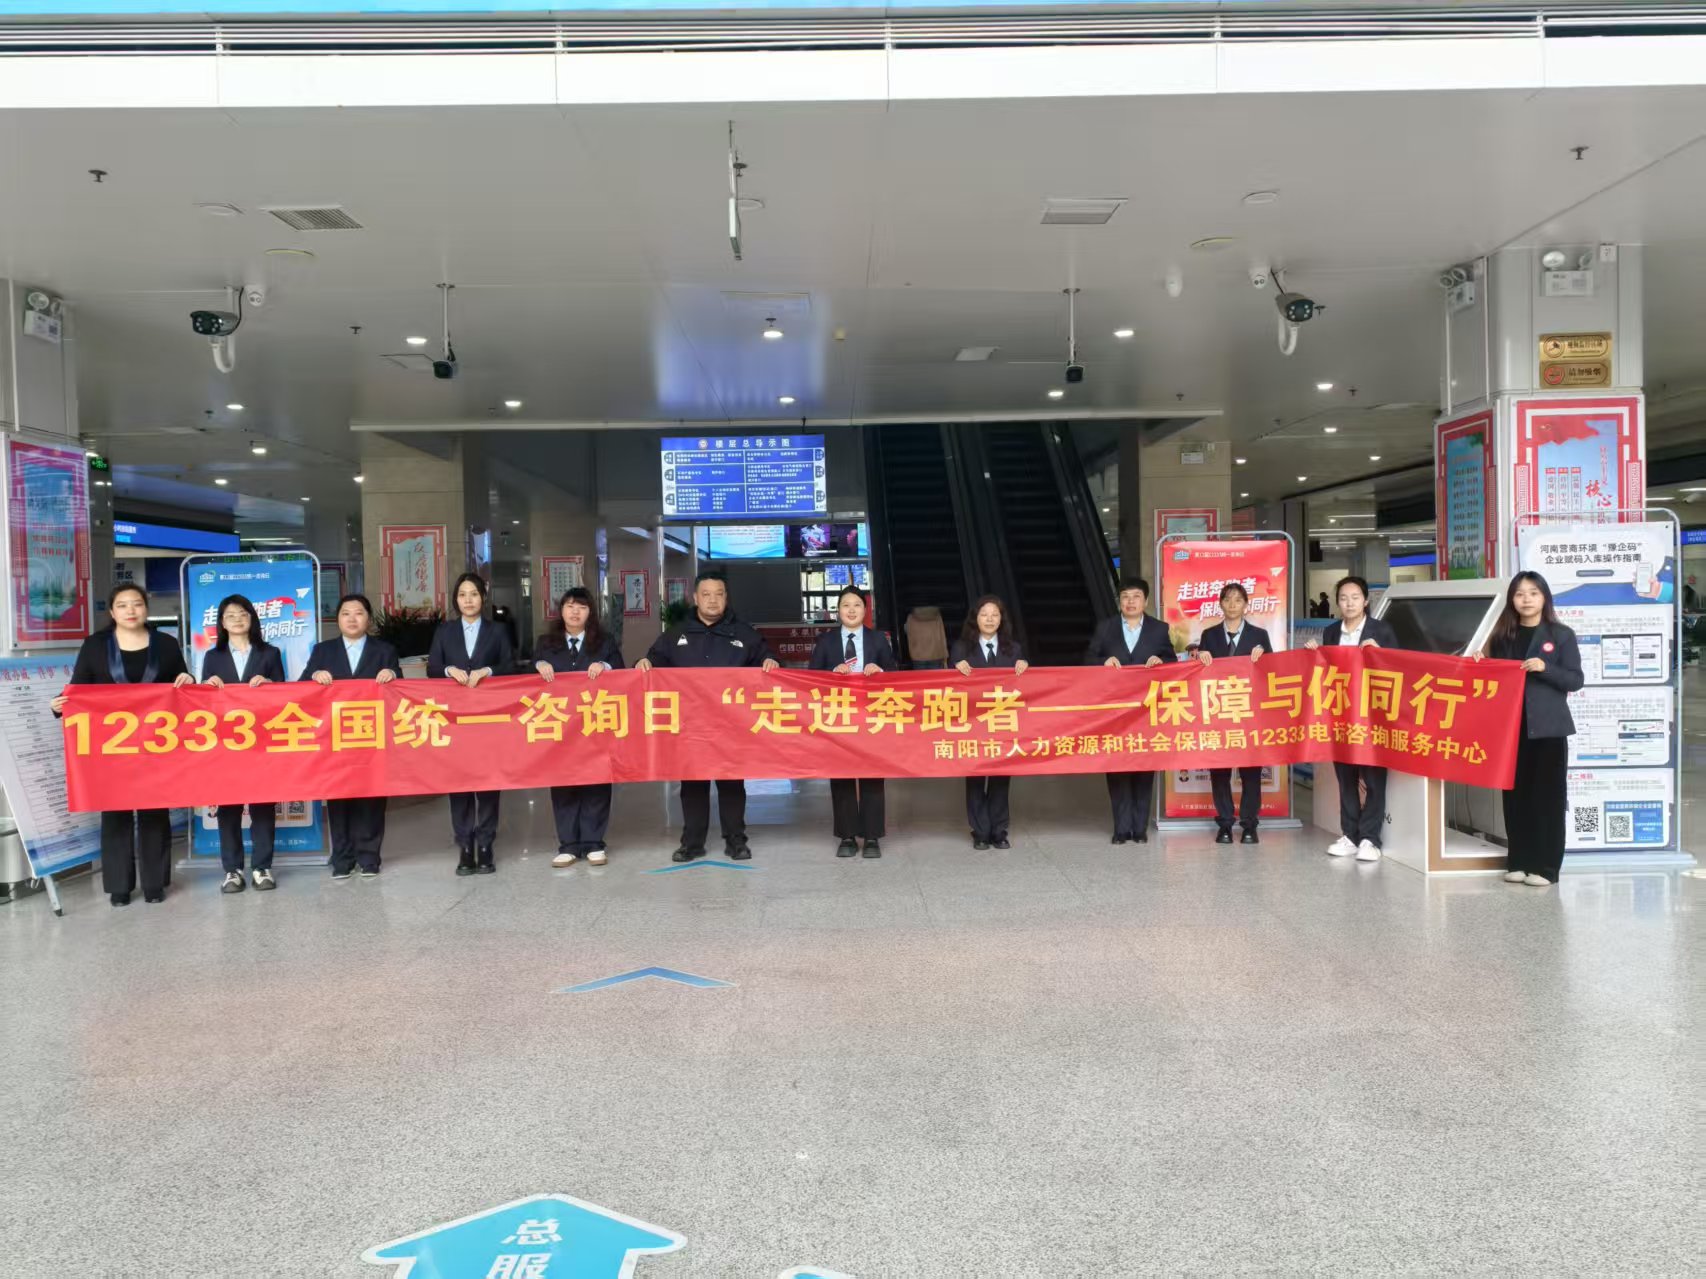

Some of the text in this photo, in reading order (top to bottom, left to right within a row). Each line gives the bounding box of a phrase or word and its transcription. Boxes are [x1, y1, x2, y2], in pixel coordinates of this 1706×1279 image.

[715, 438, 791, 449] 楼层总导示图
[202, 600, 283, 626] 走跑者
